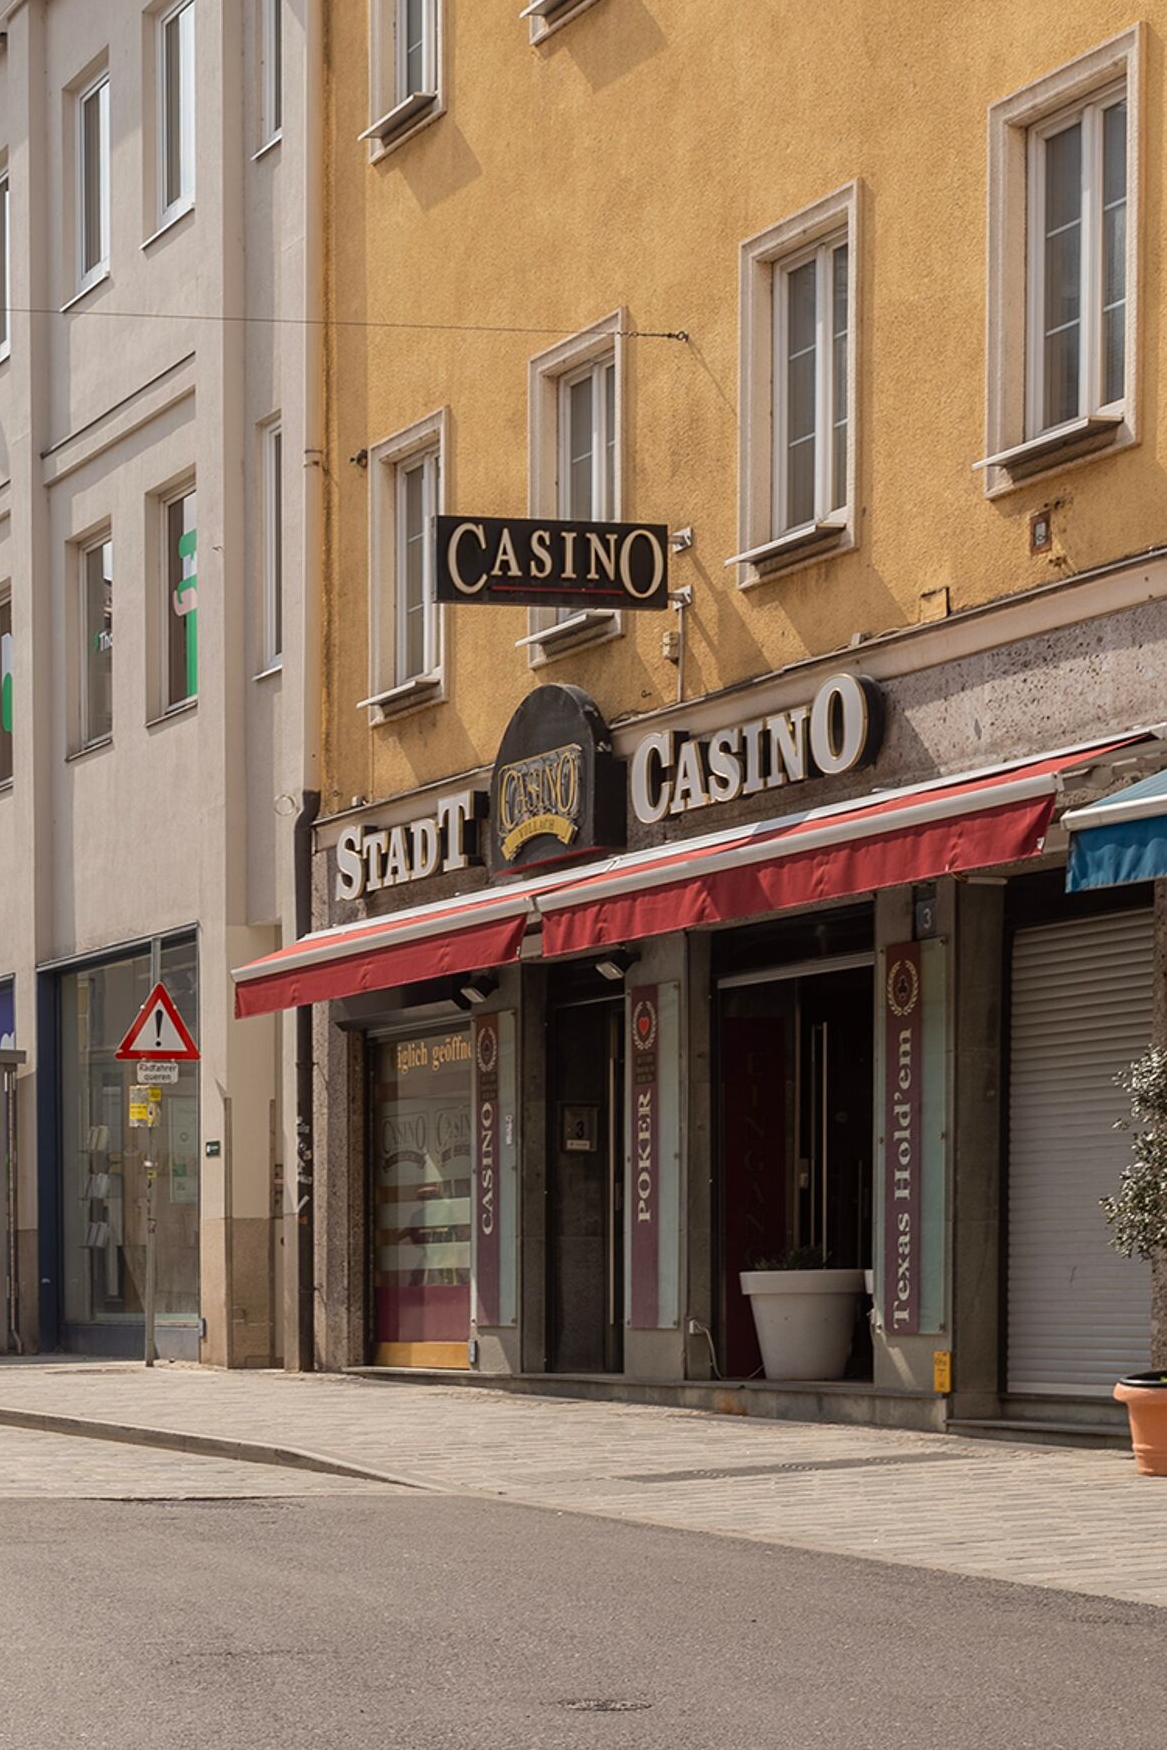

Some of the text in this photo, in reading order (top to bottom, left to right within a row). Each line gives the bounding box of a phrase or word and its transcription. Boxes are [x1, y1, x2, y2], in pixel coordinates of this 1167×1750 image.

[447, 521, 665, 599] CASINO
[336, 672, 870, 901] STADT CASINO
[500, 751, 577, 830] CASINO
[923, 907, 932, 929] 3
[139, 1063, 177, 1073] Radfahrer
[481, 1101, 494, 1235] CASINO
[637, 1090, 652, 1224] POKER
[893, 1212, 911, 1330] Texas
